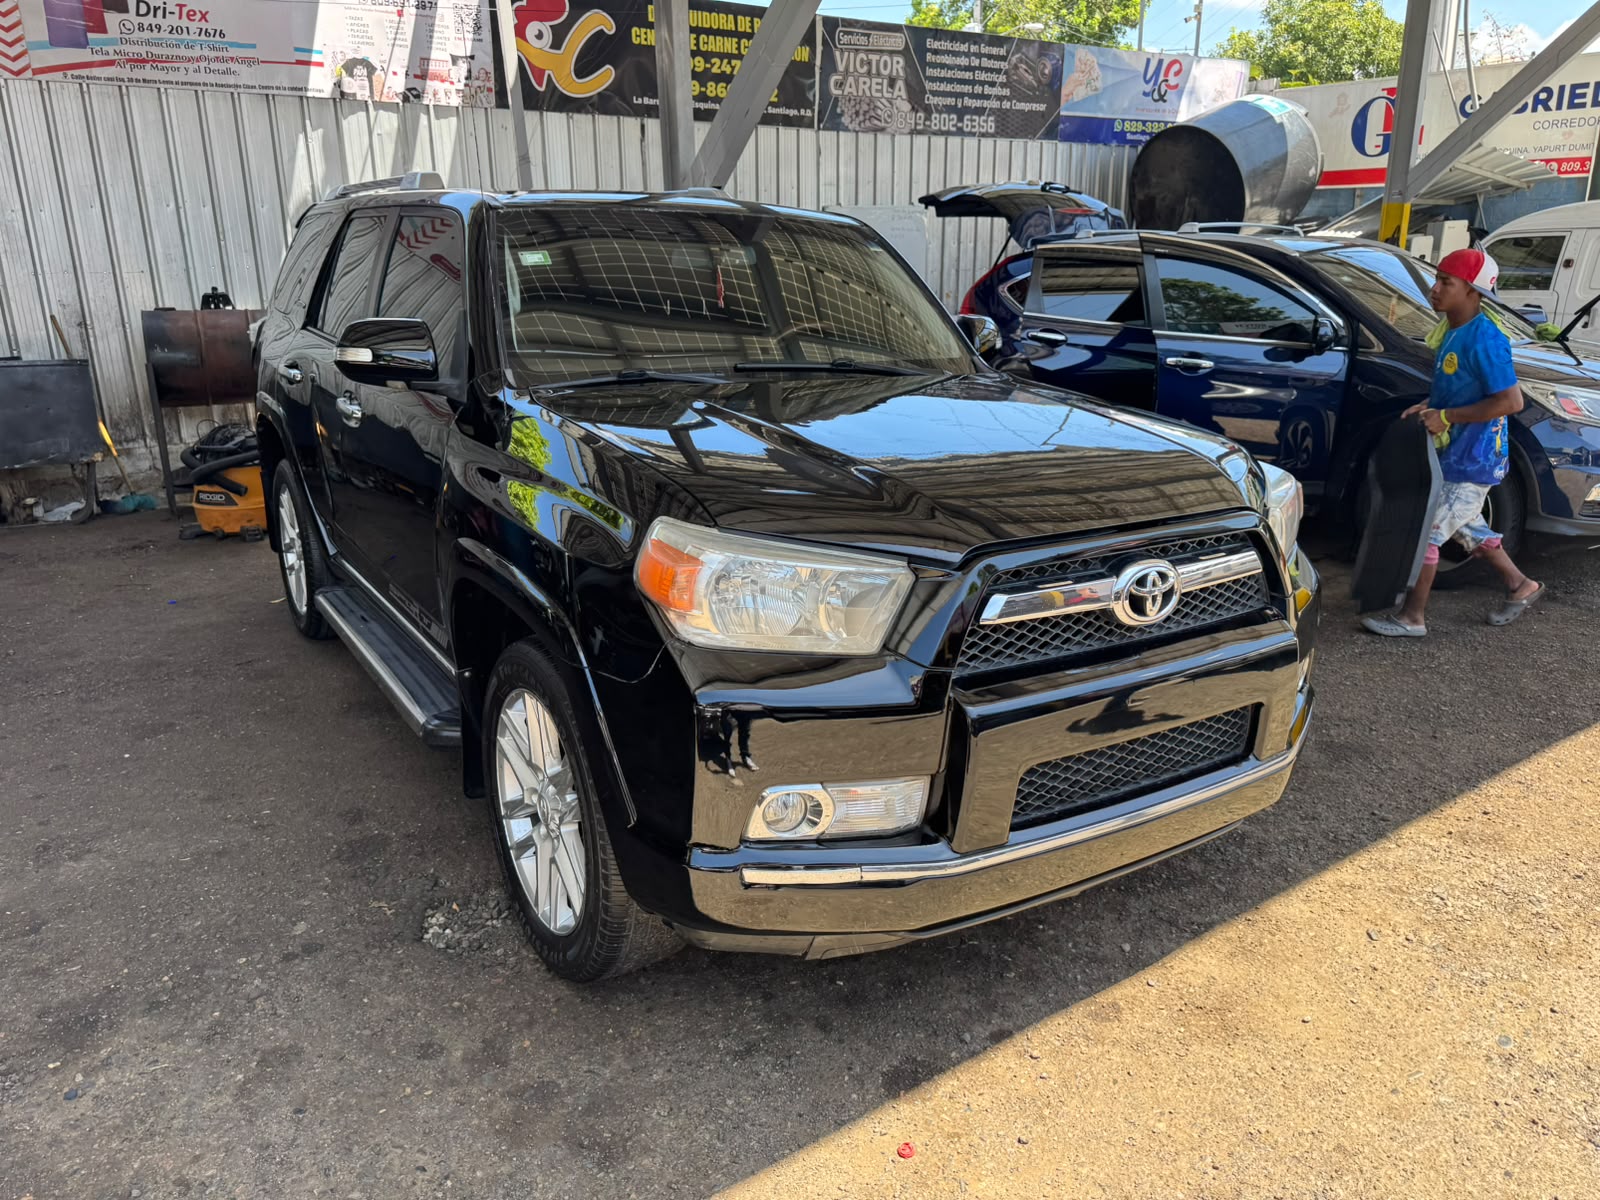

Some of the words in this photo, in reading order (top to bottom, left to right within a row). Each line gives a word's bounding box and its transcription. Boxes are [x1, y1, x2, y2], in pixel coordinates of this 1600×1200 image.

[136, 0, 210, 23] Dri-Tex
[137, 22, 226, 39] 849-201-7676
[737, 15, 752, 33] DE
[120, 36, 181, 49] Distribución
[184, 40, 196, 50] de
[198, 42, 230, 53] T-Shirt
[699, 34, 739, 55] CARNE
[840, 32, 869, 46] Servicios
[926, 38, 968, 53] Electricidad
[970, 44, 980, 54] en
[981, 44, 1006, 56] General
[89, 47, 110, 57] Tela
[113, 48, 143, 59] Micro
[145, 50, 188, 62] Durazno
[199, 54, 215, 65] Ojo
[219, 56, 231, 64] de
[233, 56, 260, 69] Ángel
[835, 50, 904, 77] VICTOR
[970, 56, 980, 67] De
[981, 58, 1009, 70] Motores
[115, 60, 126, 70] Al
[129, 63, 147, 73] por
[150, 64, 182, 75] Mayor
[184, 68, 190, 76] y
[193, 66, 202, 74] al
[204, 66, 240, 77] Detalle.
[926, 66, 974, 80] Instalaciones
[974, 70, 1007, 83] Eléctricas
[830, 75, 908, 99] CARELA
[926, 80, 972, 94] Instalaciones
[974, 84, 982, 94] de
[984, 85, 1010, 96] Bombas
[633, 96, 642, 104] La
[768, 106, 800, 117] Santiago,
[925, 94, 956, 107] Chequeo
[957, 98, 962, 108] y
[964, 96, 1000, 110] Reparación
[1002, 100, 1010, 110] de
[1012, 100, 1048, 112] Compresor
[897, 112, 996, 133] 849-802-6356
